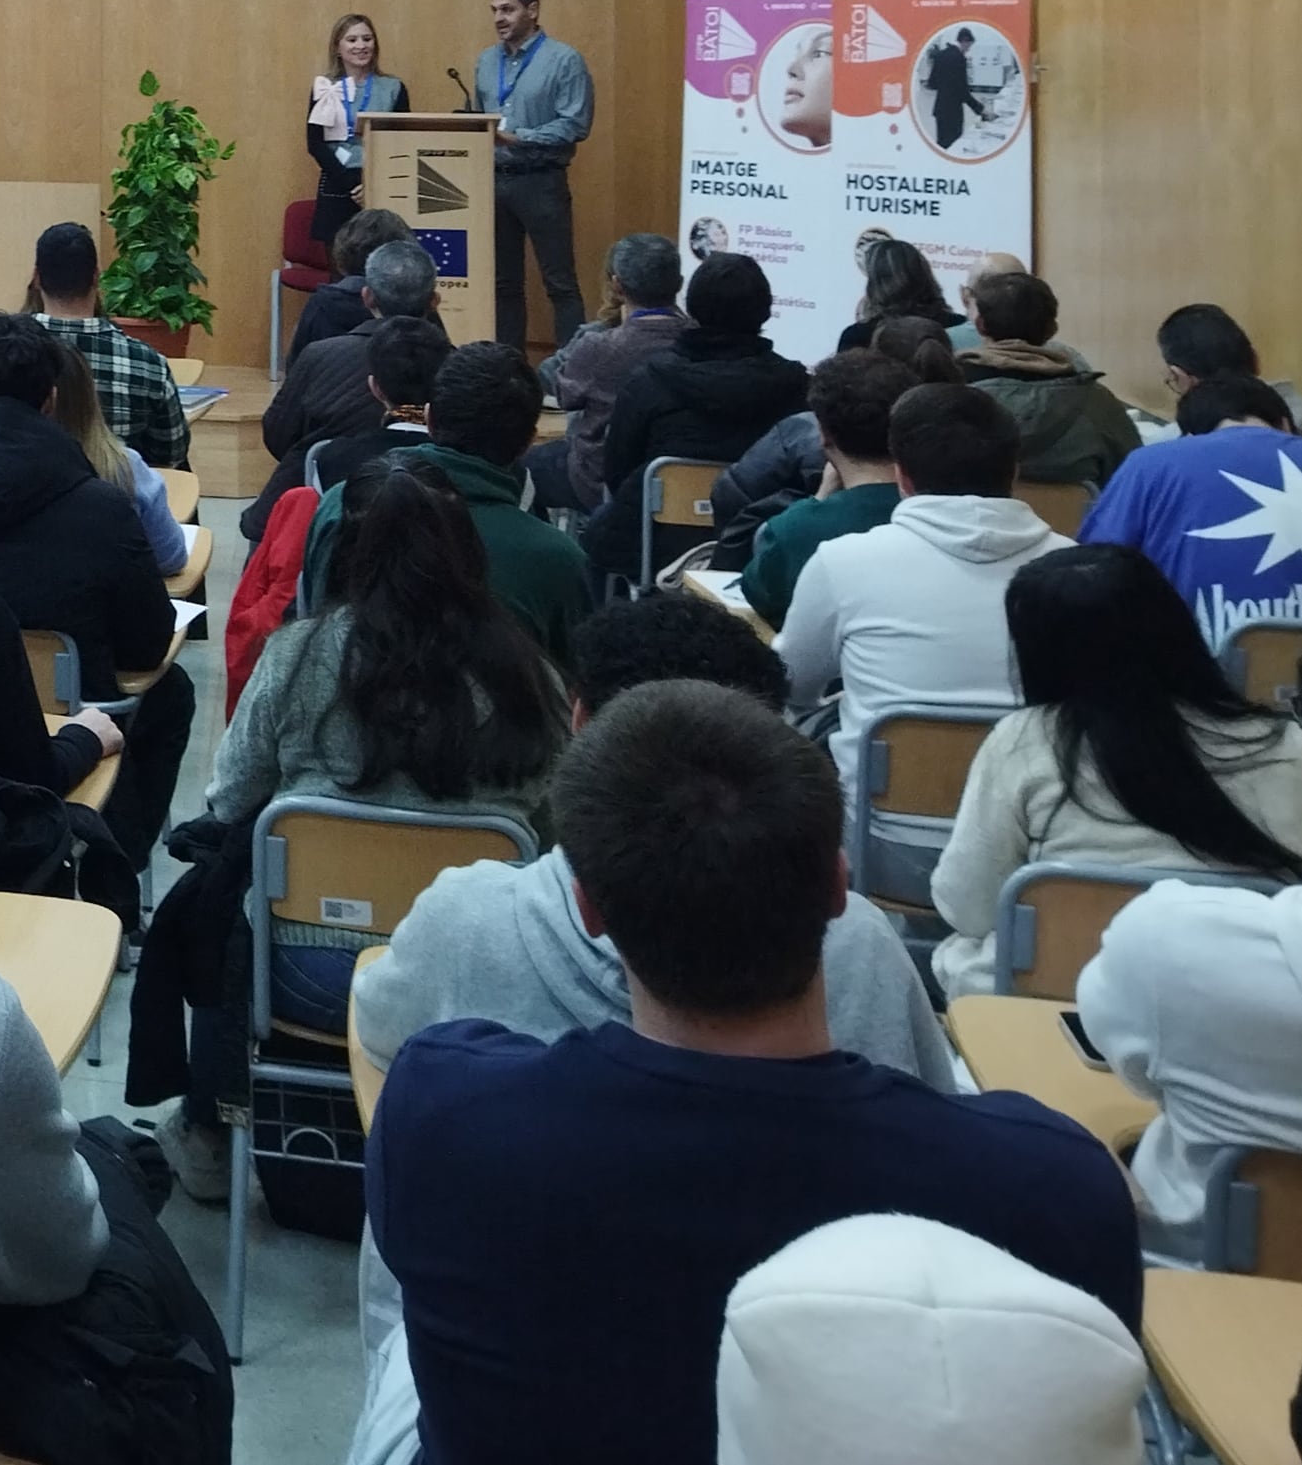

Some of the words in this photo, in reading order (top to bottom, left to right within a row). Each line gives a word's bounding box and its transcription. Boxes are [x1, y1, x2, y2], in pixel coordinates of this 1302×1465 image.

[703, 6, 720, 62] BATOI
[850, 3, 867, 63] BATOI
[690, 159, 758, 178] IMATGE
[690, 179, 789, 200] PERSONAL
[846, 173, 971, 196] HOSTALERIA
[845, 195, 851, 211] I
[855, 196, 942, 216] TURISME
[738, 224, 753, 234] FP
[913, 242, 945, 255] FGM
